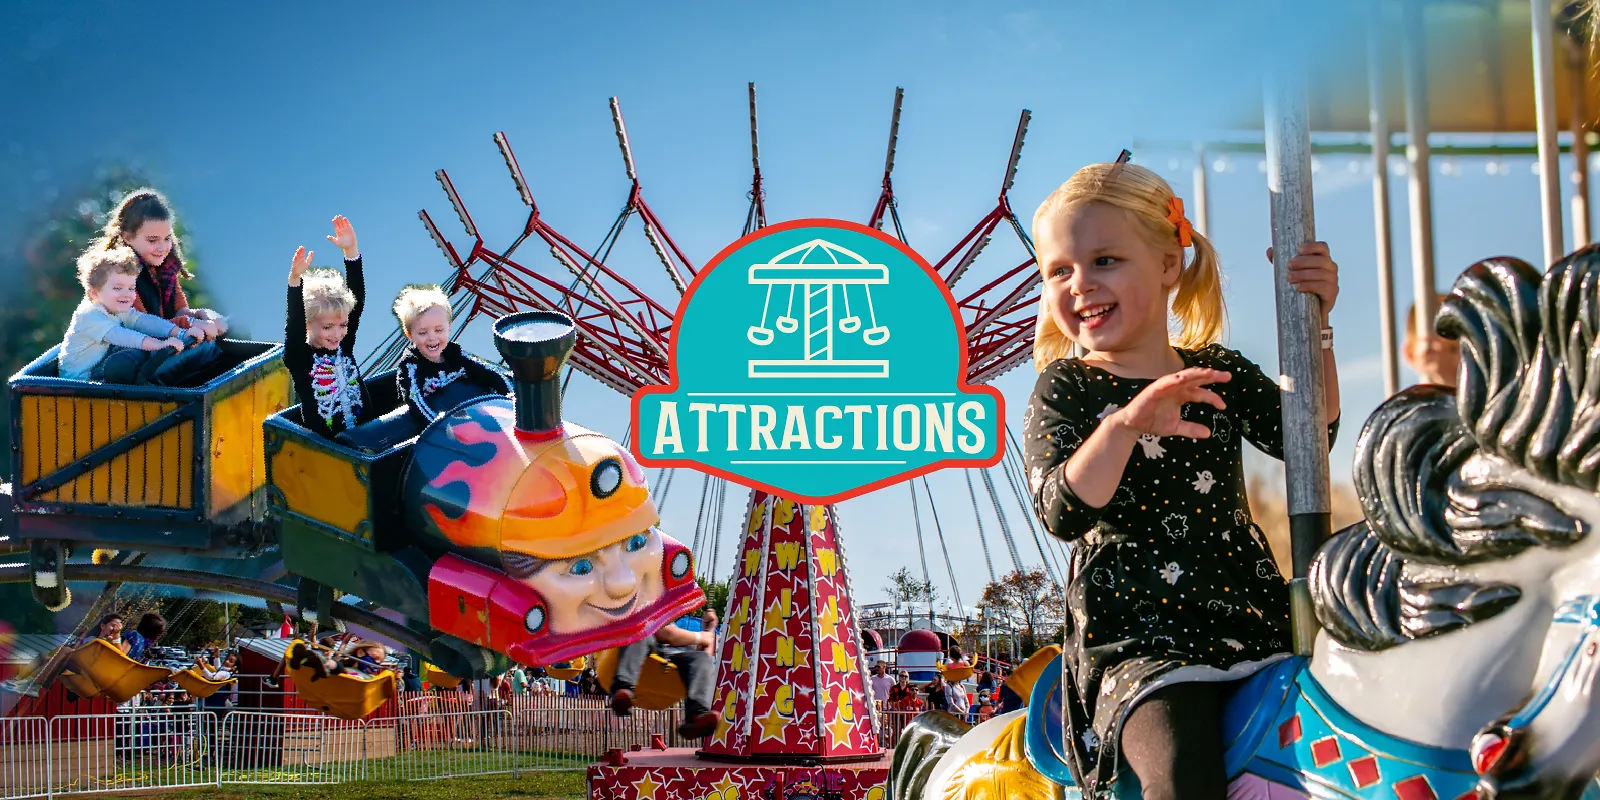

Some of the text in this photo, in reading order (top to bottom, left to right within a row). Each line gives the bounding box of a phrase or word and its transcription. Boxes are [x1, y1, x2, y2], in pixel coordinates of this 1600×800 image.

[725, 503, 765, 721] SWING
[774, 499, 801, 715] SWING
[815, 505, 854, 722] SWING
